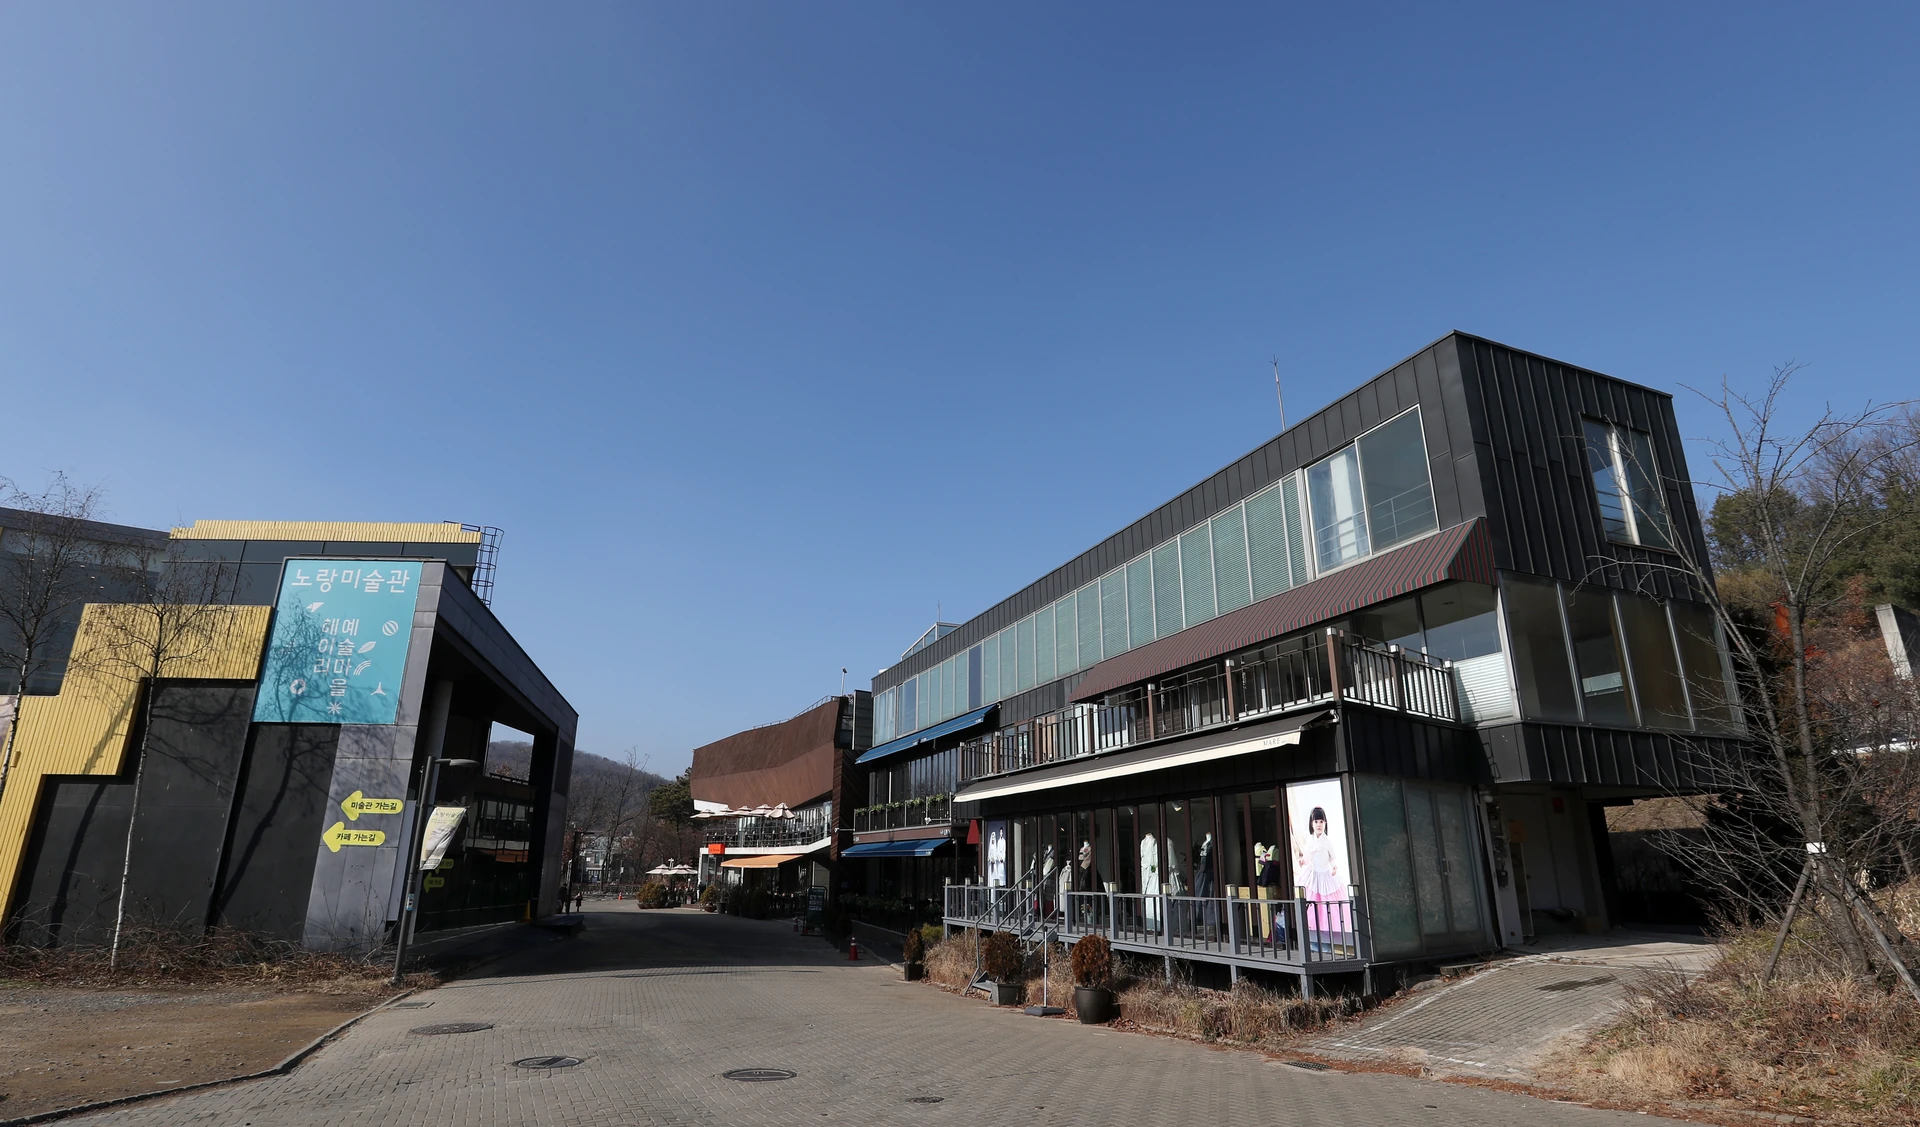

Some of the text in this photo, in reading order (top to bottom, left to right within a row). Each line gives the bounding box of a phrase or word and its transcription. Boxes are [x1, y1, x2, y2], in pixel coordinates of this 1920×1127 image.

[291, 568, 410, 593] 노랑미술관
[1263, 737, 1281, 746] MARE
[351, 801, 398, 810] 미술관 가는길
[336, 833, 376, 842] 카페 가는길
